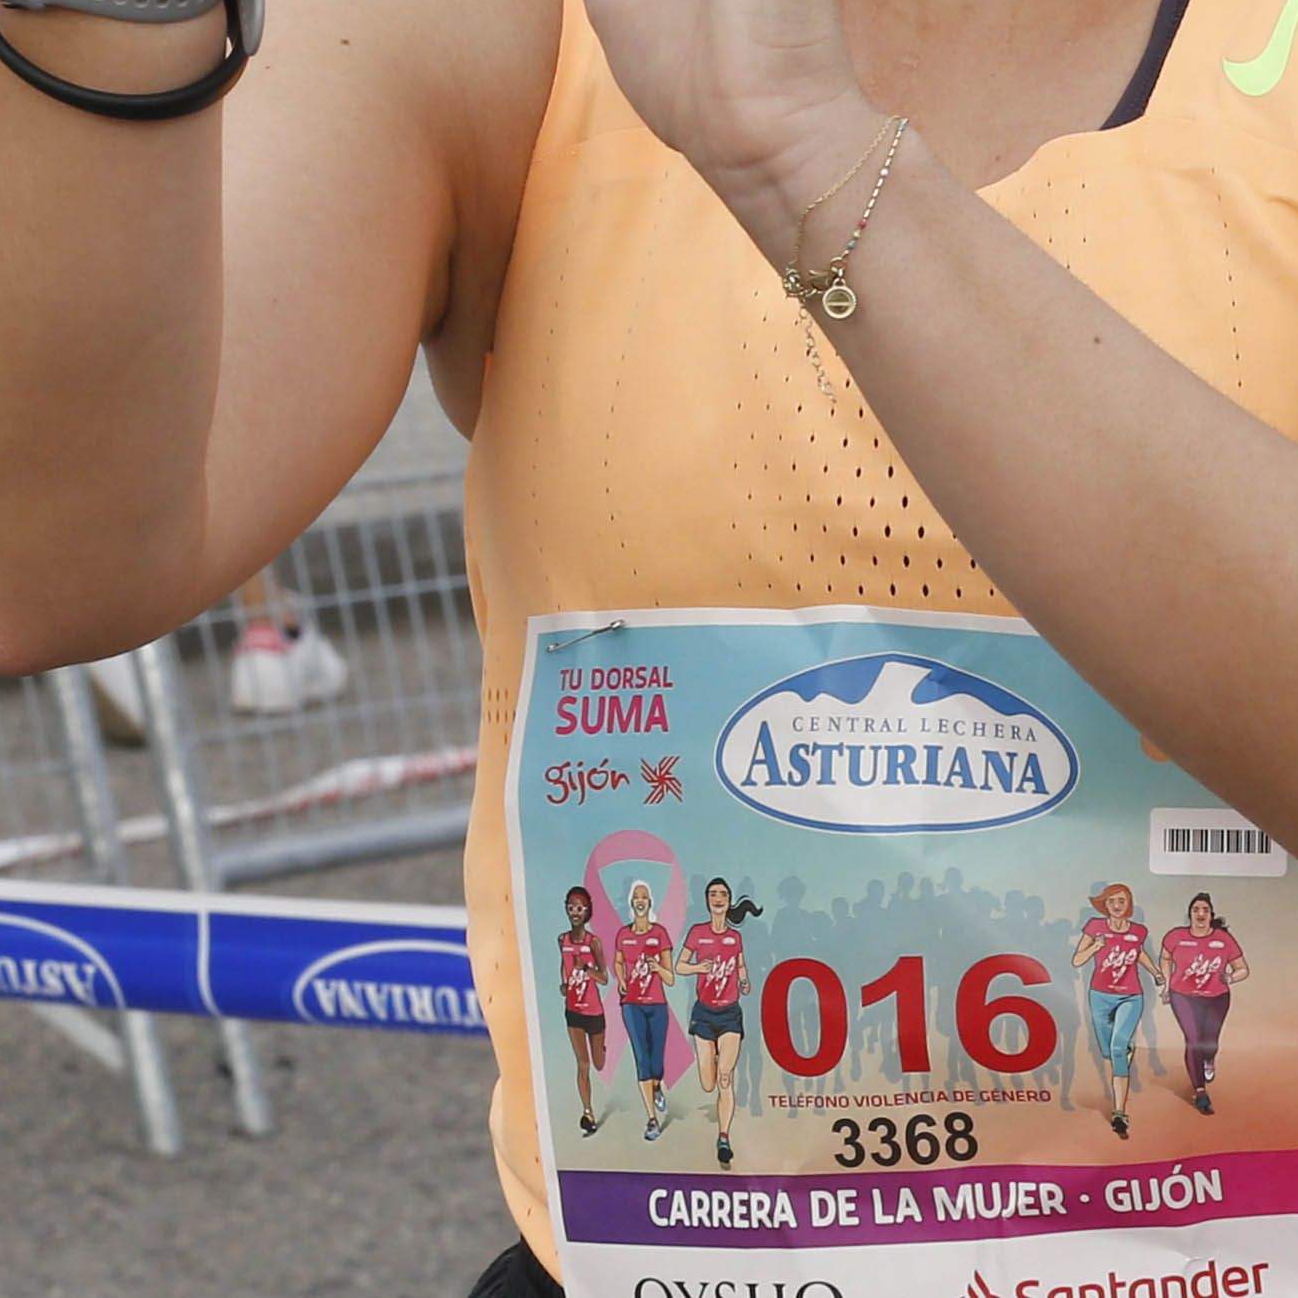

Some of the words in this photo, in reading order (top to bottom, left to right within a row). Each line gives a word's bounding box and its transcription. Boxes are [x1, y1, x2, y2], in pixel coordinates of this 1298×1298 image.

[560, 668, 583, 691] TU
[590, 665, 674, 691] DORSAL
[555, 693, 669, 735] SUMA
[792, 716, 908, 734] CENTRAL
[920, 717, 1038, 742] LECHERA
[545, 758, 630, 805] gijón
[740, 720, 1051, 795] ASTURIANA
[312, 978, 487, 1027] TURIANA
[760, 953, 1058, 1078] 016
[768, 1091, 850, 1109] TELÉFONO
[852, 1089, 946, 1108] VIOLENCIA
[953, 1090, 975, 1103] DE
[979, 1088, 1052, 1103] GÉNERO
[831, 1111, 979, 1168] 3368
[649, 1188, 798, 1229] CARRERA
[810, 1189, 860, 1227] DE
[871, 1187, 923, 1225] LA
[932, 1181, 1068, 1222] MUJER
[1104, 1164, 1224, 1213] GIJÓN
